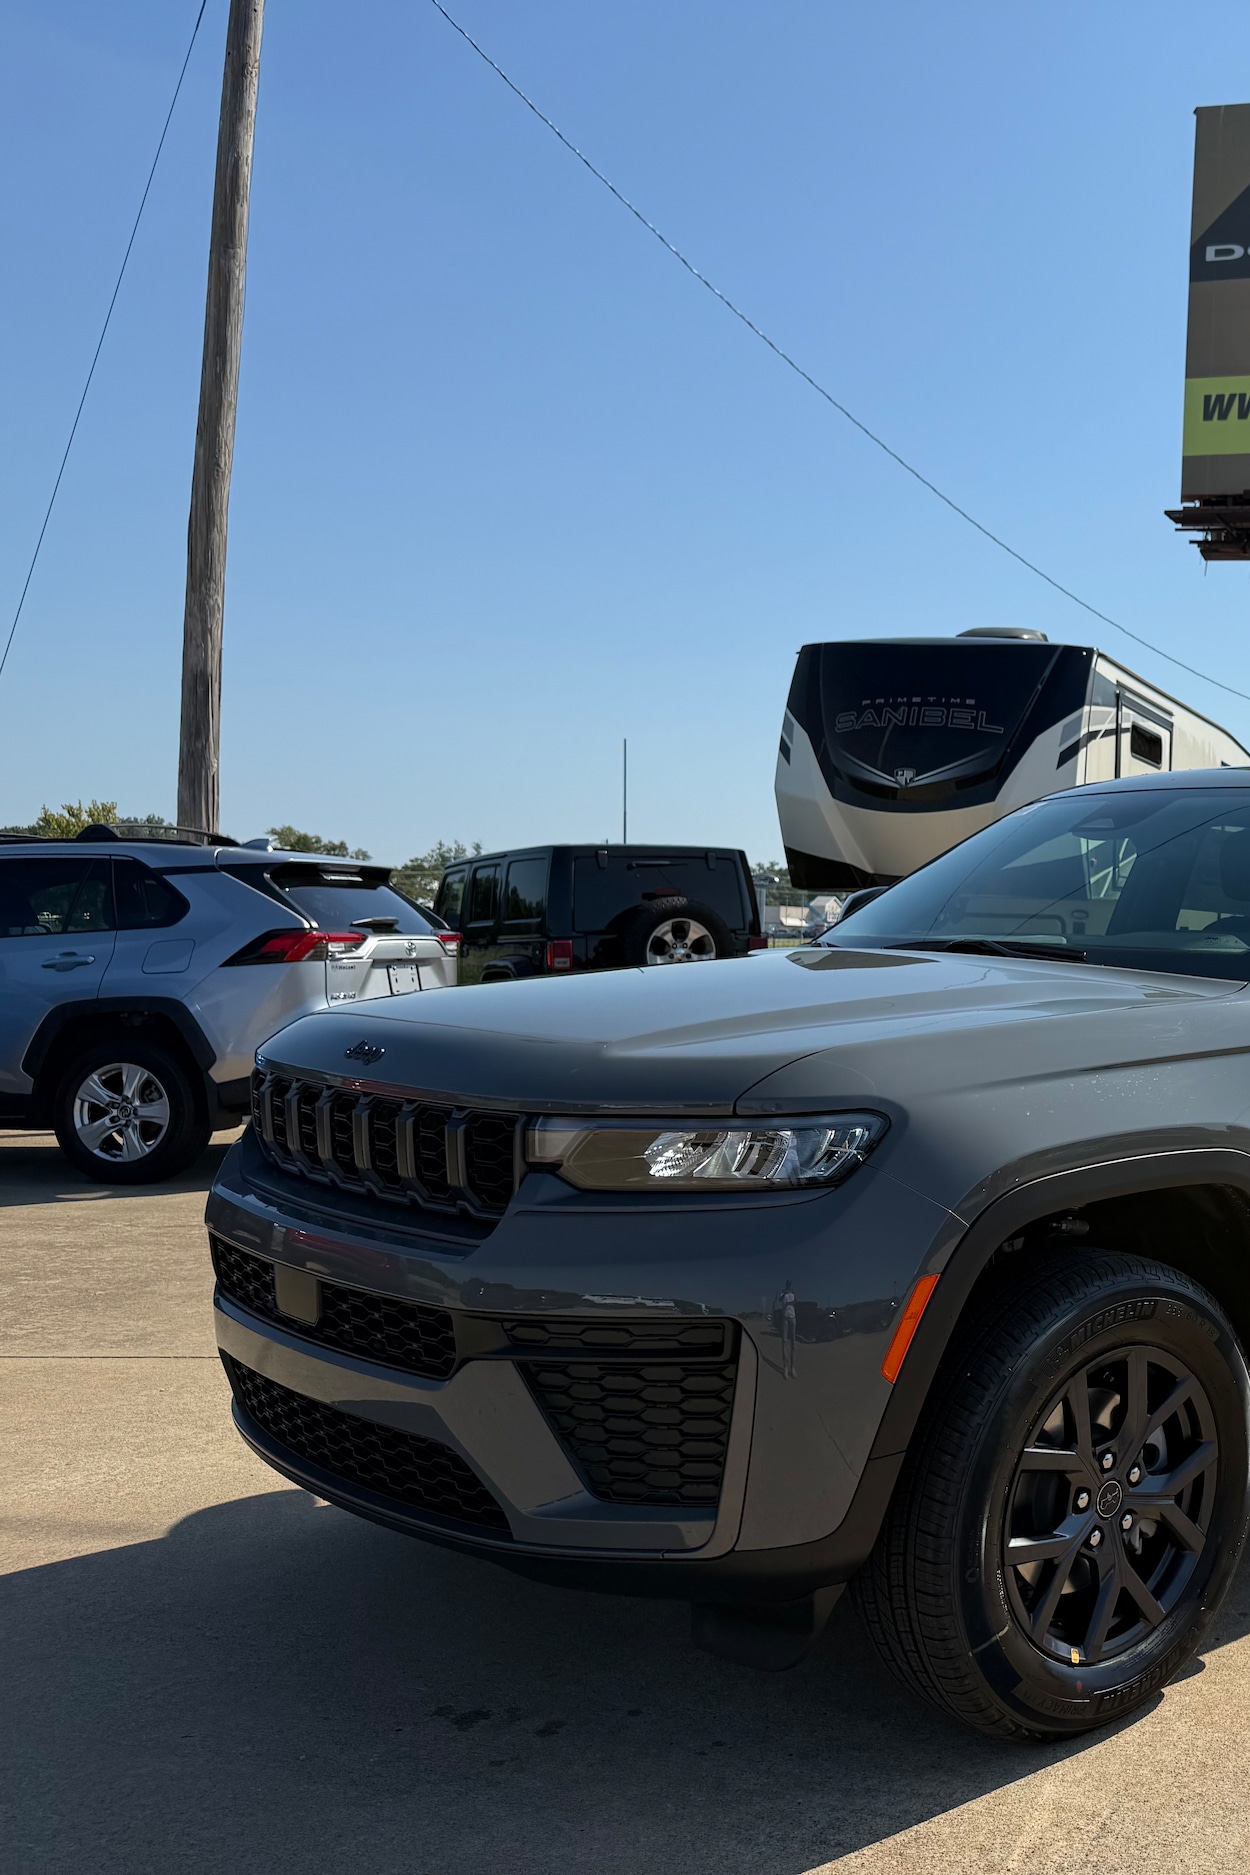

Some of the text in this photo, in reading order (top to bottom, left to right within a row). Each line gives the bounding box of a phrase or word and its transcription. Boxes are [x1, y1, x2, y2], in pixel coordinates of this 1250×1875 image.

[835, 706, 1004, 734] SANIBEL
[344, 1039, 386, 1066] Jeep
[1070, 1300, 1156, 1351] MICHELIN
[1186, 1312, 1198, 1323] 60
[1199, 1319, 1206, 1329] R
[1206, 1327, 1215, 1338] 18
[1037, 1698, 1087, 1716] PRIMACY
